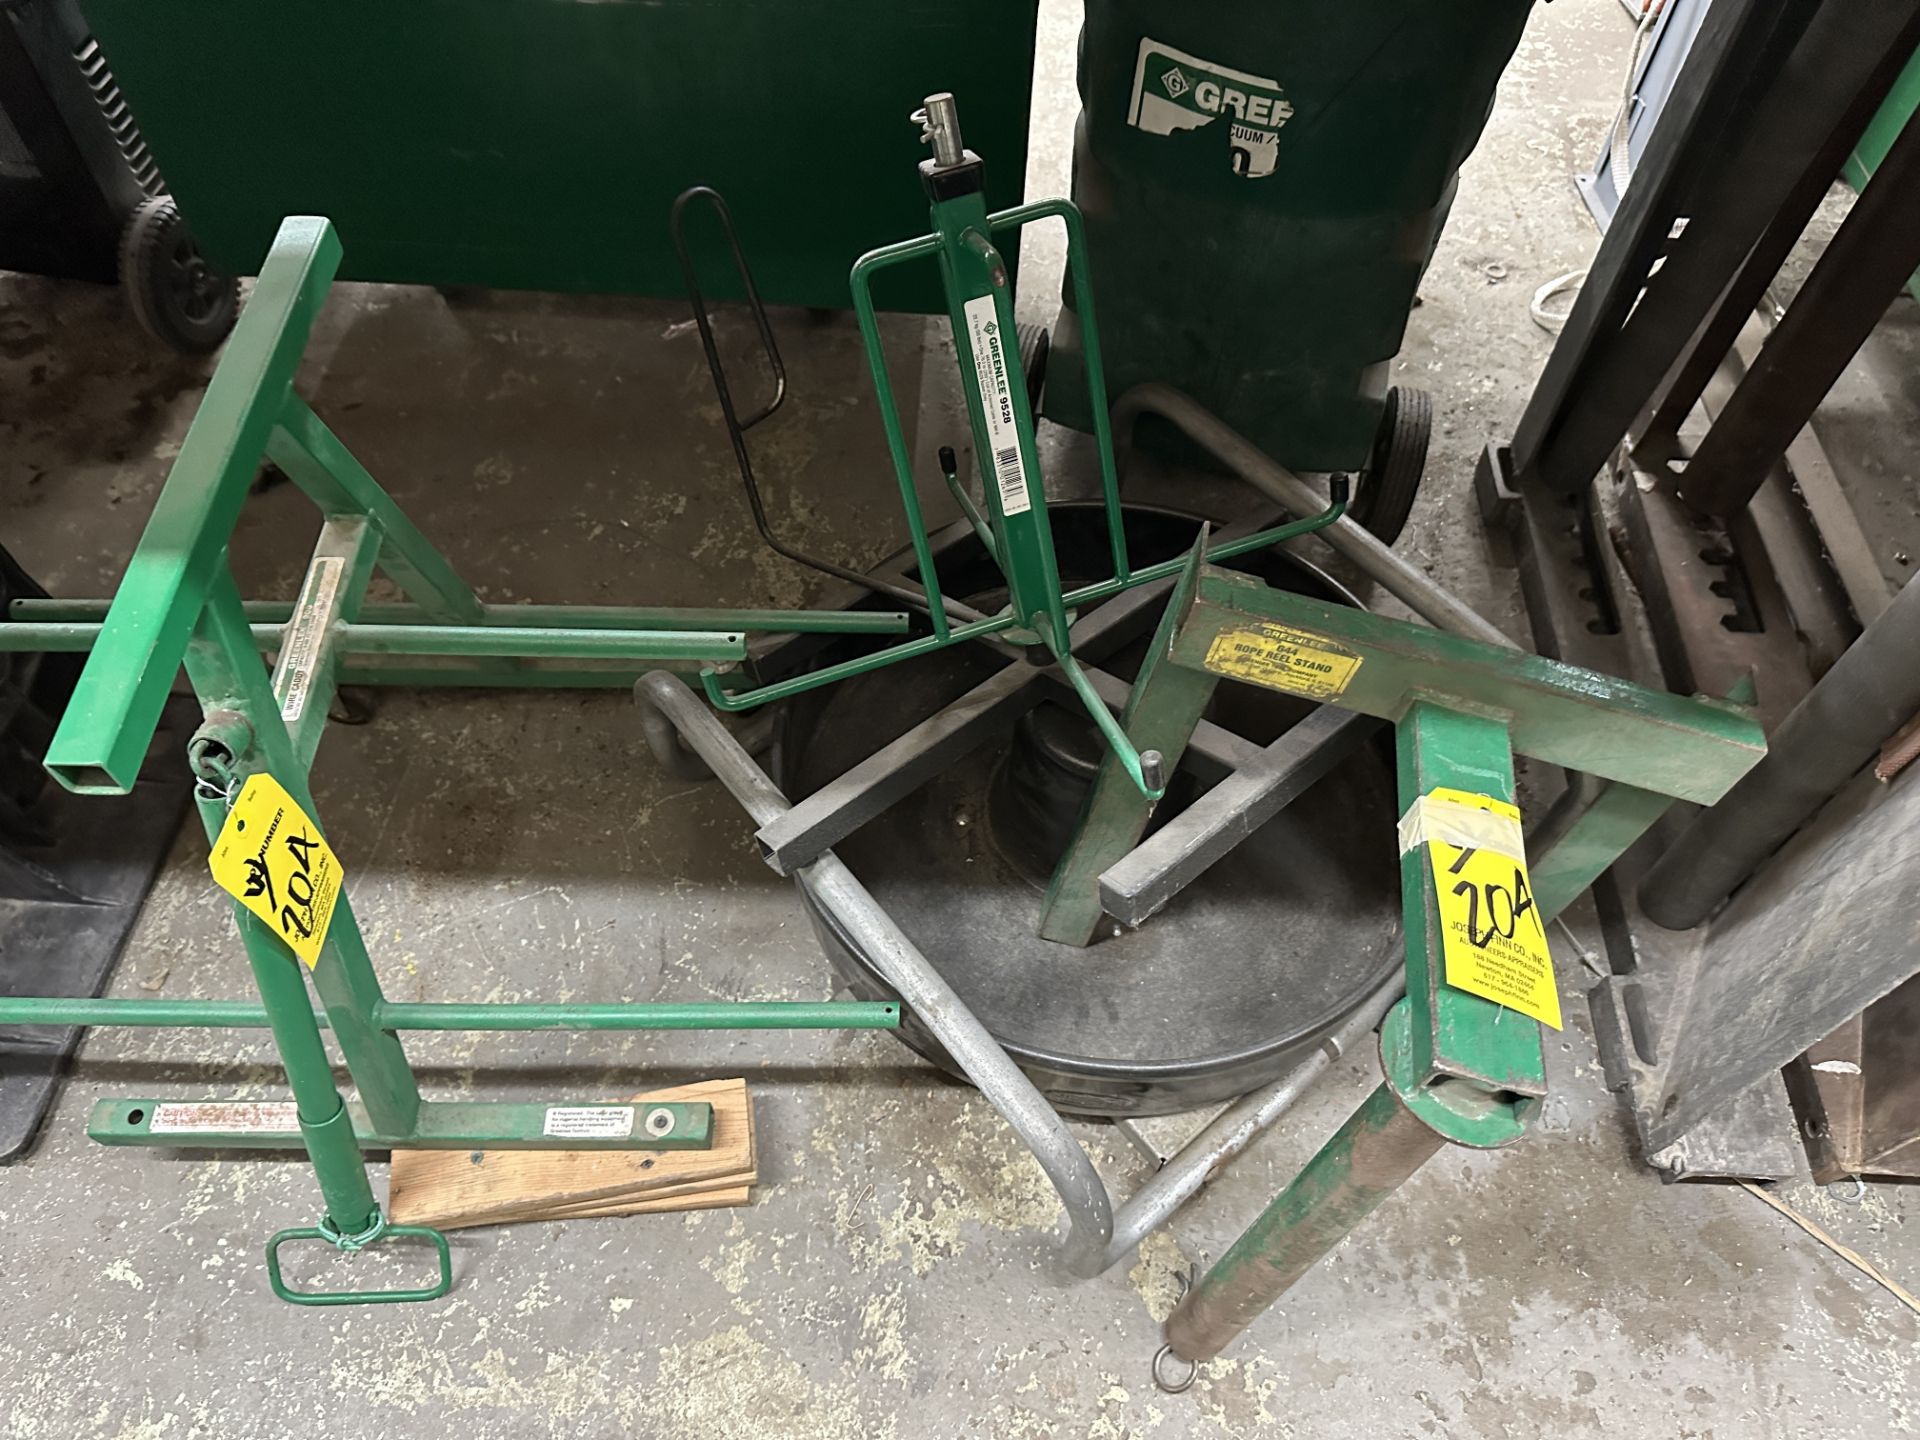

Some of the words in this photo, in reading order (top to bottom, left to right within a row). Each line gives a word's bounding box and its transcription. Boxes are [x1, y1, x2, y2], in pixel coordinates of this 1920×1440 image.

[1231, 125, 1264, 144] CUUM
[988, 337, 1006, 394] GREENLEE
[999, 397, 1011, 424] 9528
[1263, 629, 1324, 648] GREENLEE
[1234, 643, 1263, 656] ROPE
[1265, 650, 1291, 663] REEL
[1294, 658, 1332, 673] STAND
[258, 807, 284, 857] NUMBER
